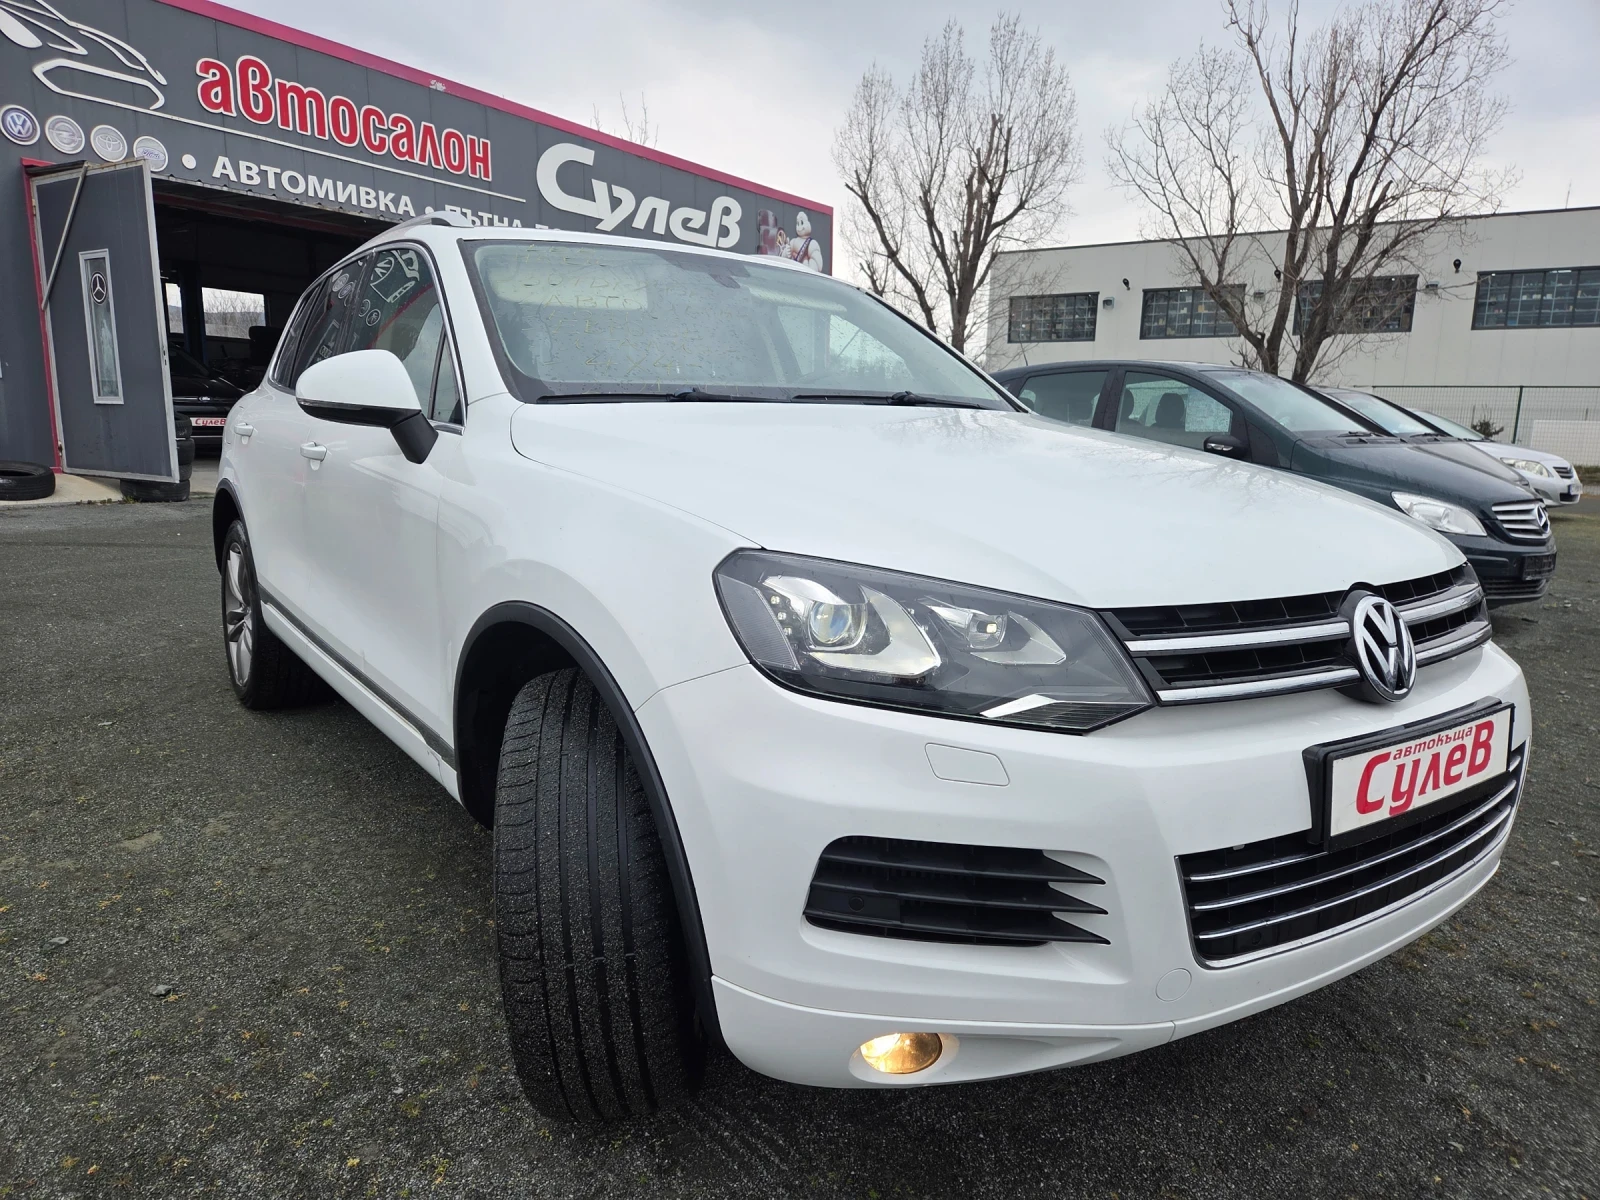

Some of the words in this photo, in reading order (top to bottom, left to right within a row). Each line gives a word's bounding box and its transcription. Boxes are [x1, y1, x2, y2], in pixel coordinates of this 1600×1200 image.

[196, 54, 493, 182] автосалон
[212, 155, 416, 217] АВТОМИВКА
[1393, 726, 1473, 760] автокъща
